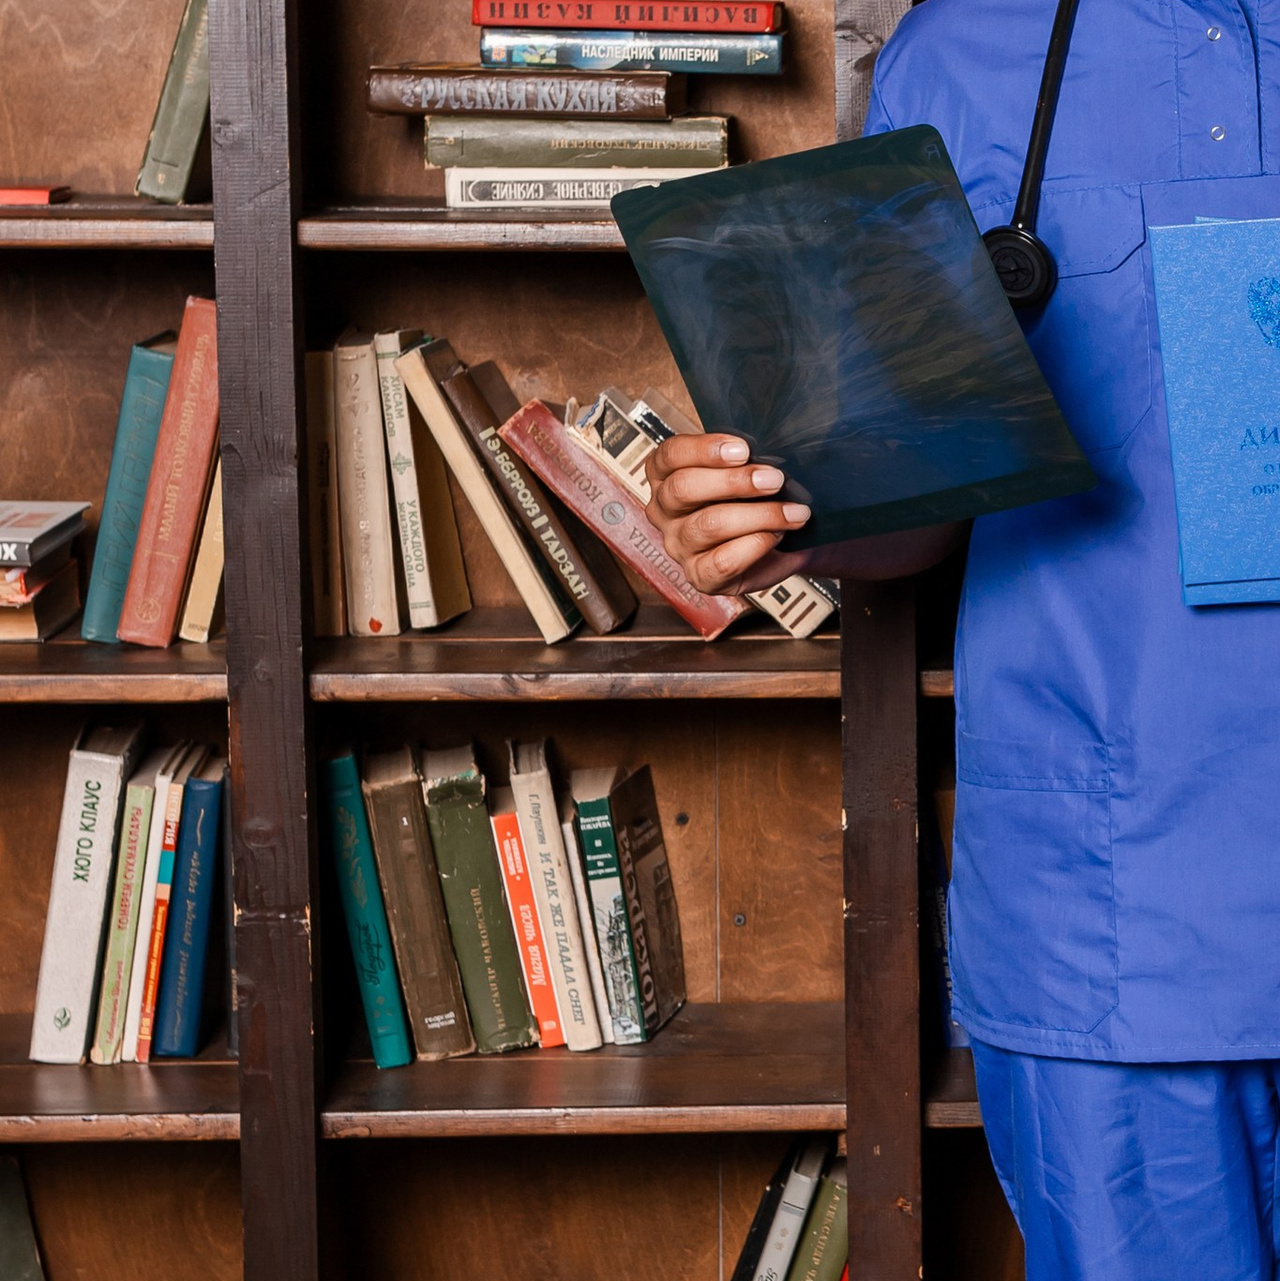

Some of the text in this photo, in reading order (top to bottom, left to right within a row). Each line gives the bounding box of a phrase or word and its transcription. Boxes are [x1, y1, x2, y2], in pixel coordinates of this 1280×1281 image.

[488, 1, 756, 22] ВАСИЛИЙ КАЗИН
[581, 44, 718, 62] НАСЛЕДНИК ИМПЕРИИ
[420, 78, 617, 112] РУССКАЯ КУХНЯ
[491, 181, 621, 199] СЕВЕРНОЕ СИЯНИЕ
[380, 376, 395, 437] КАМАЛОВ
[390, 375, 404, 419] ХИСАМ
[157, 332, 209, 541] МАЛЫЙ ТОЛКОВЫЙ СЛОВАРЬ
[1263, 463, 1274, 475] О
[406, 499, 424, 573] У КАЖДОГО
[538, 526, 590, 601] ТАРЗАН
[71, 778, 102, 883] ХЮГО КЛАУС
[538, 850, 553, 866] И
[541, 868, 560, 899] ТАК
[549, 901, 566, 929] ЖЕ
[518, 903, 546, 987] Магия чисел
[553, 929, 577, 984] ПАДАЛ
[567, 986, 586, 1027] СНЕГ
